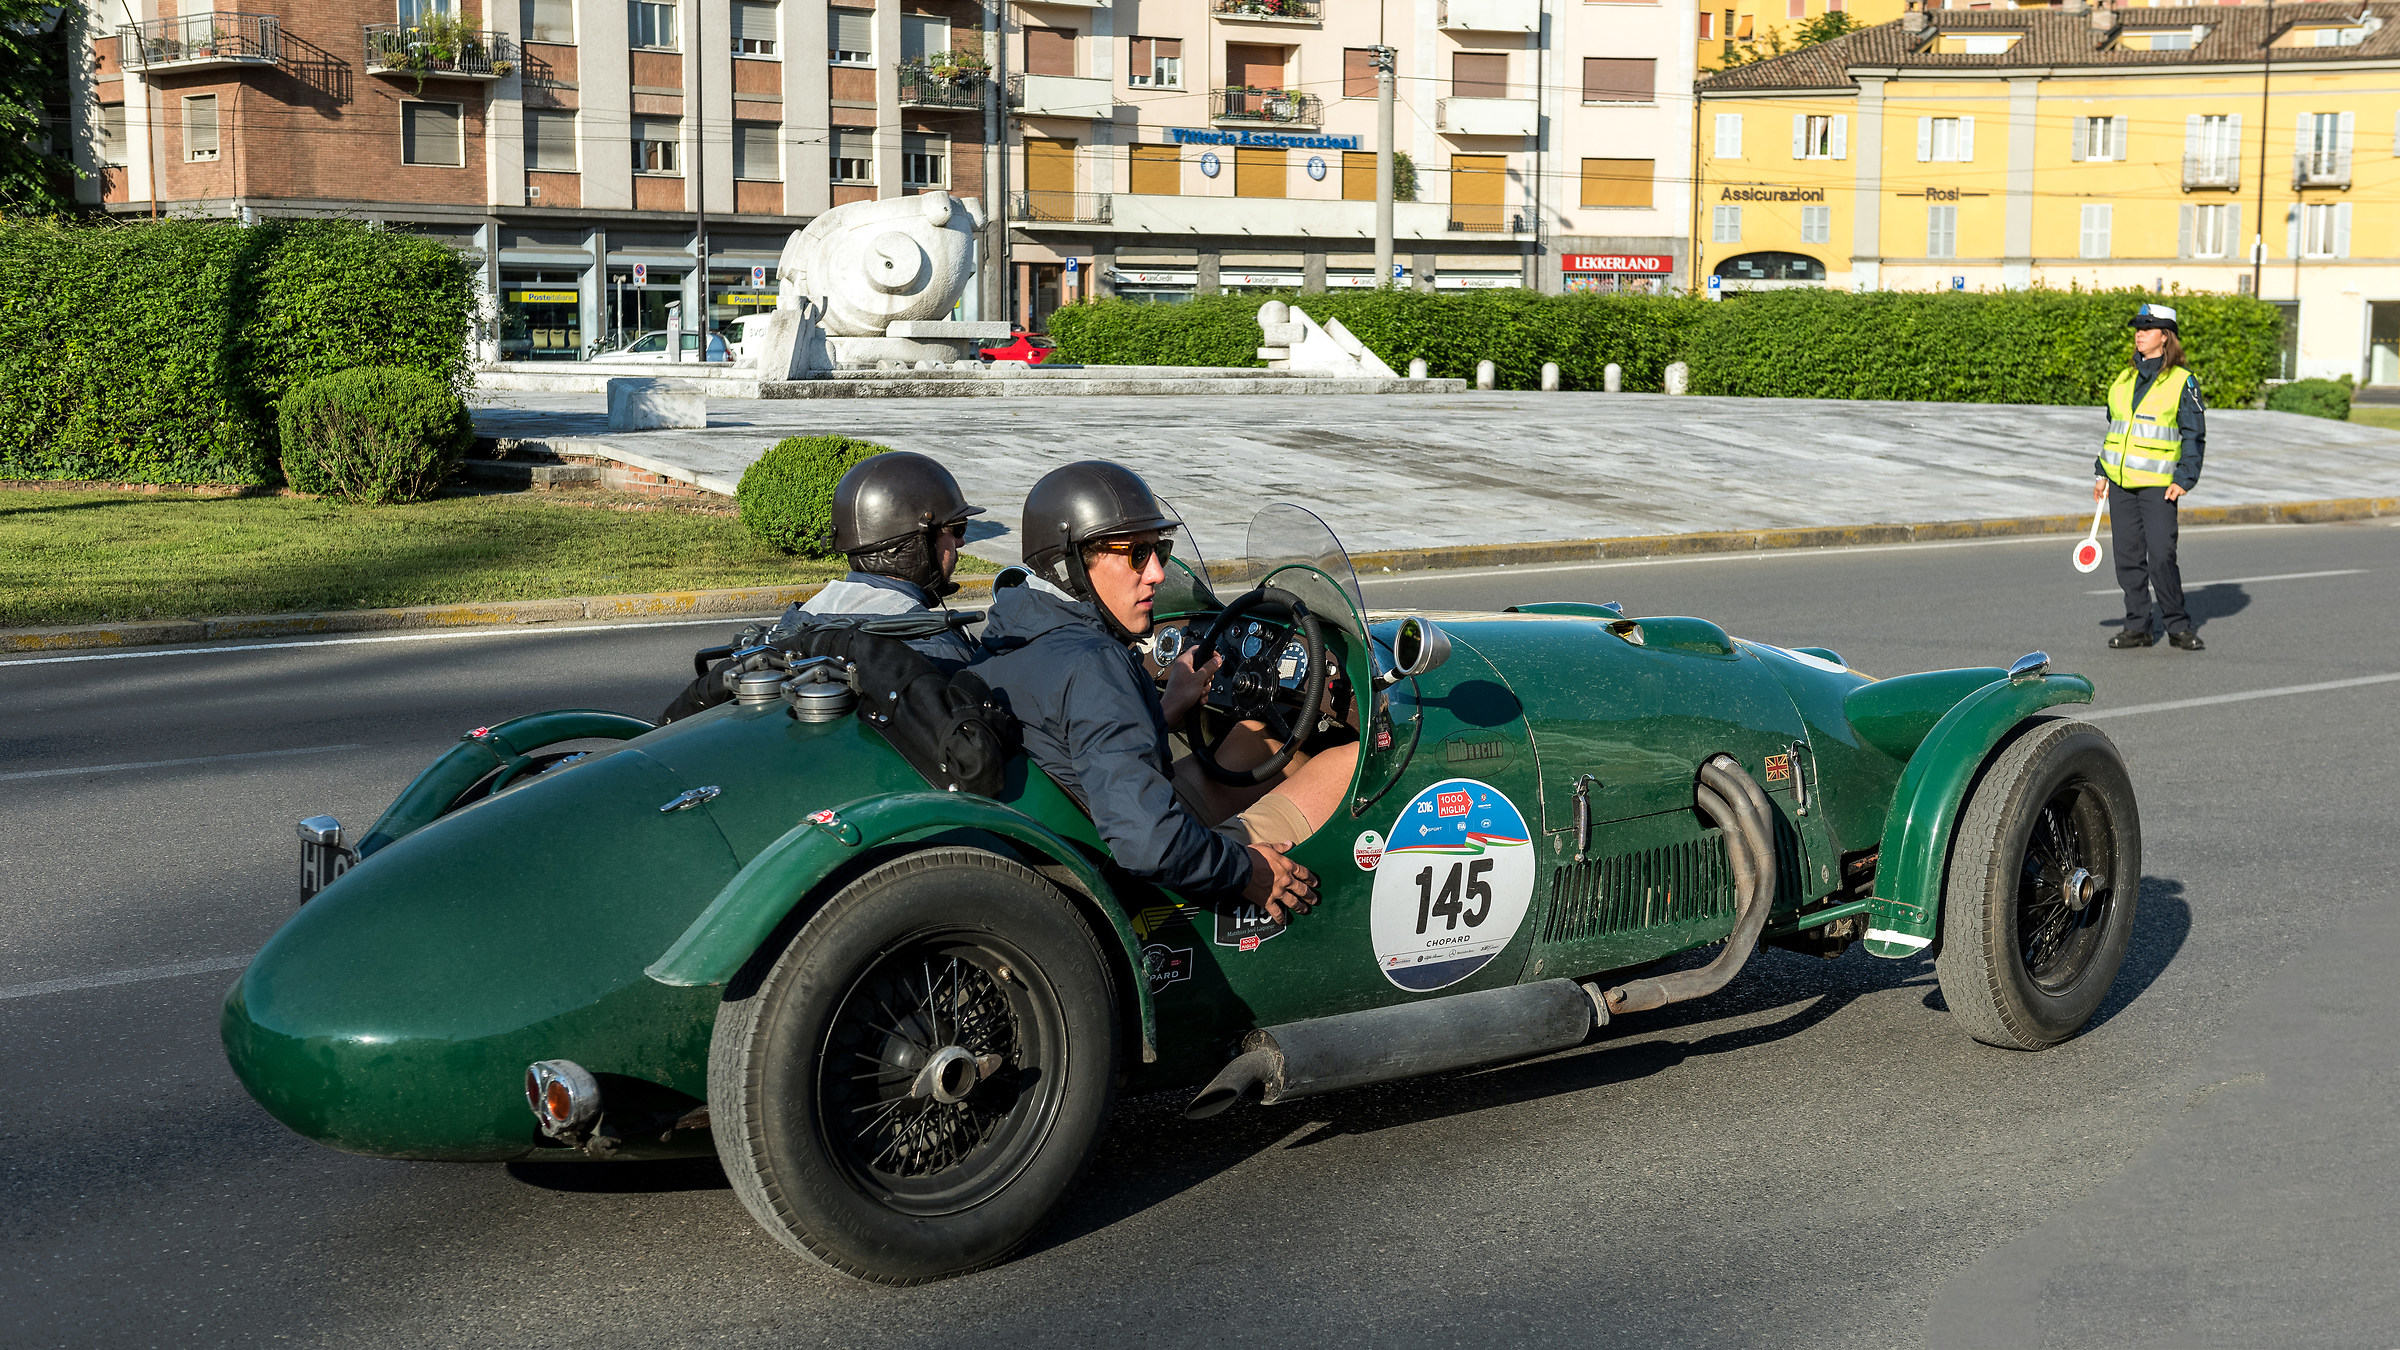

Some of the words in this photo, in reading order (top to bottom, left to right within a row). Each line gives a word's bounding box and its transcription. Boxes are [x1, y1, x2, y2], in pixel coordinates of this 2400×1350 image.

[1172, 129, 1235, 145] Vittoria
[1237, 130, 1357, 149] Assicurazioni
[1721, 187, 1824, 201] Assicurazioni
[1926, 187, 1960, 201] Rosi
[1575, 256, 1660, 270] LEKKERLAND
[1146, 273, 1173, 282] UniCredit
[1251, 276, 1279, 285] UniCredit
[1440, 794, 1463, 804] 1000
[1417, 801, 1434, 814] 2016
[1440, 804, 1466, 815] MIGLIA
[1358, 856, 1377, 864] CHECK
[1415, 858, 1494, 935] 145
[1426, 934, 1471, 948] CHOPARD
[1150, 971, 1179, 981] PARD
